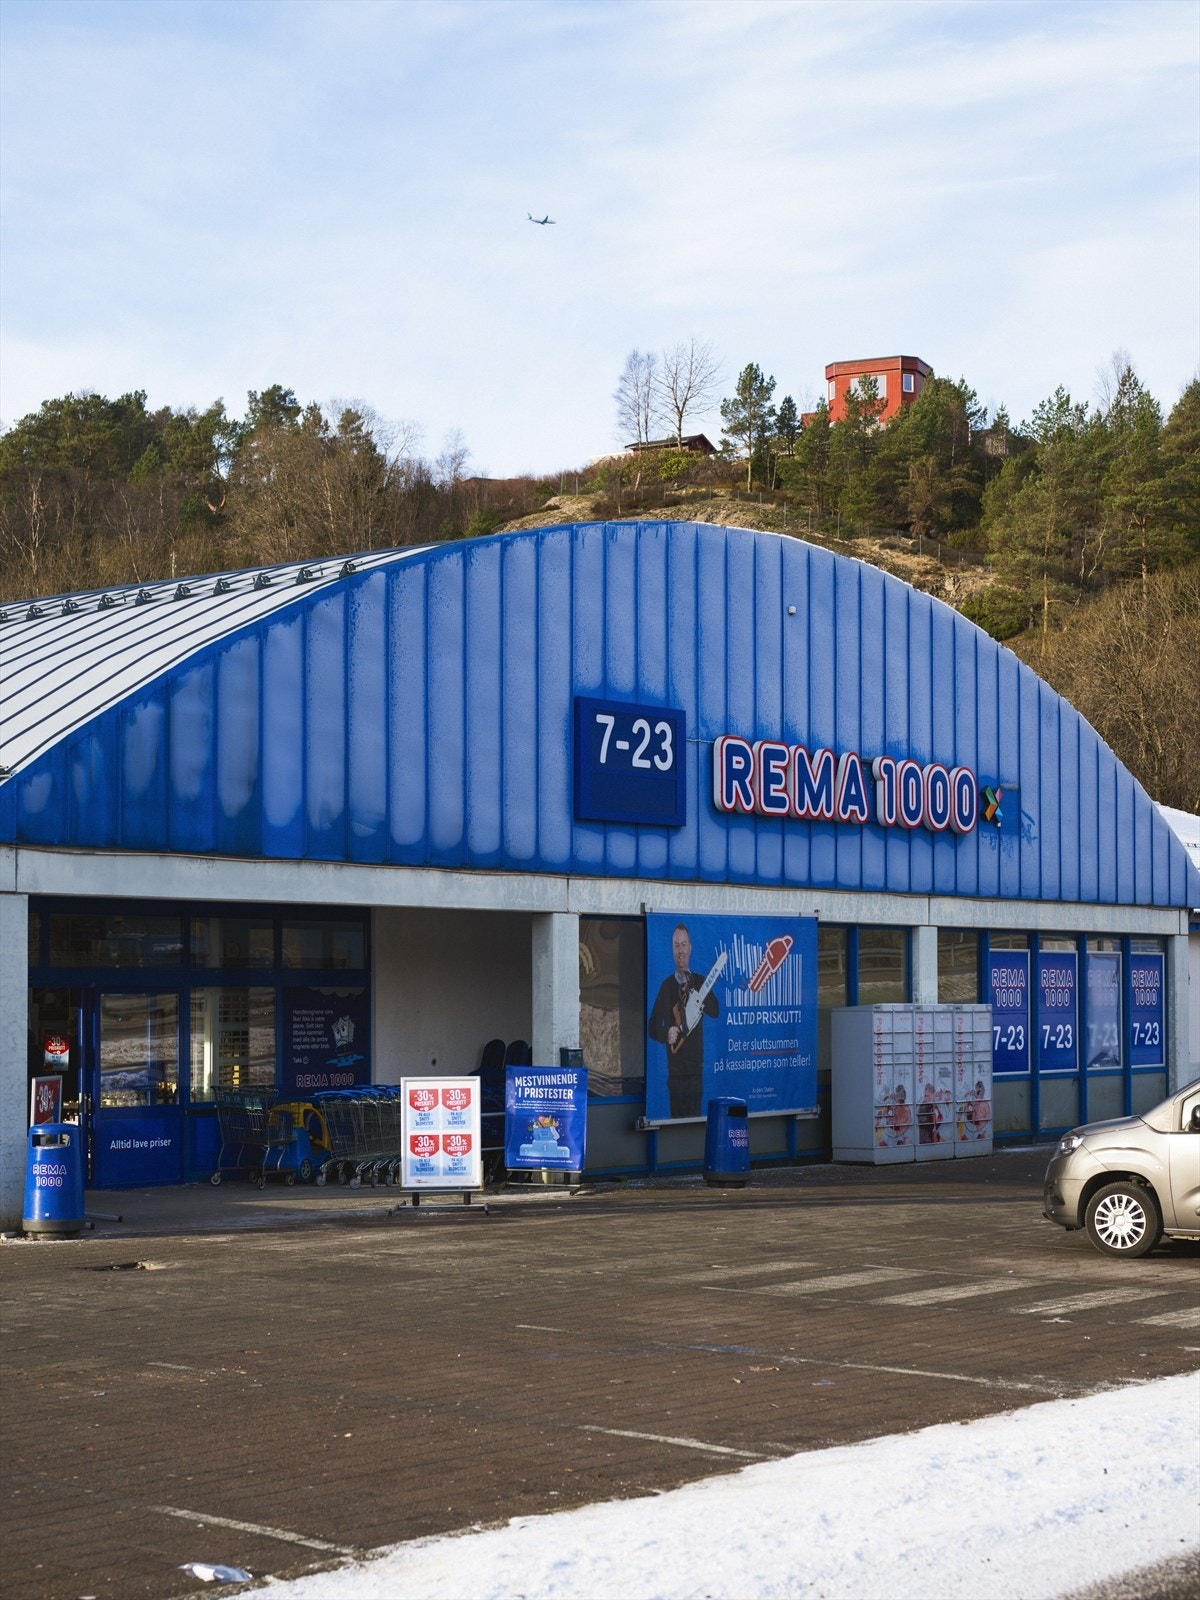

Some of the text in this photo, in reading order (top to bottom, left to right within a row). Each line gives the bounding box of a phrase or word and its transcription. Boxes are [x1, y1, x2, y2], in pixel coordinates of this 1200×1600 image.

[596, 714, 673, 771] 7-23
[713, 735, 977, 835] REMA 1000
[991, 968, 1025, 988] REMA
[1040, 969, 1074, 988] REMA
[1131, 970, 1160, 988] REMA
[995, 988, 1022, 1007] 1000
[1044, 988, 1071, 1007] 1000
[1092, 989, 1115, 1006] 00
[1134, 988, 1157, 1006] 1000
[726, 1010, 801, 1026] ALLTID PRISKUTT!
[993, 1025, 1025, 1050] 7-23
[1042, 1024, 1073, 1049] 7-23
[1132, 1022, 1160, 1046] 7-23
[728, 1037, 799, 1051] Det er sluttsummen
[714, 1054, 811, 1073] på kassalappen som teller!
[296, 1073, 355, 1088] REMA 1000
[514, 1073, 578, 1087] MESTVINNENDE
[518, 1087, 573, 1099] I PRISTESTER
[110, 1138, 172, 1150] Alltid lave priser
[32, 1164, 67, 1175] REMA
[36, 1176, 63, 1187] 1000
